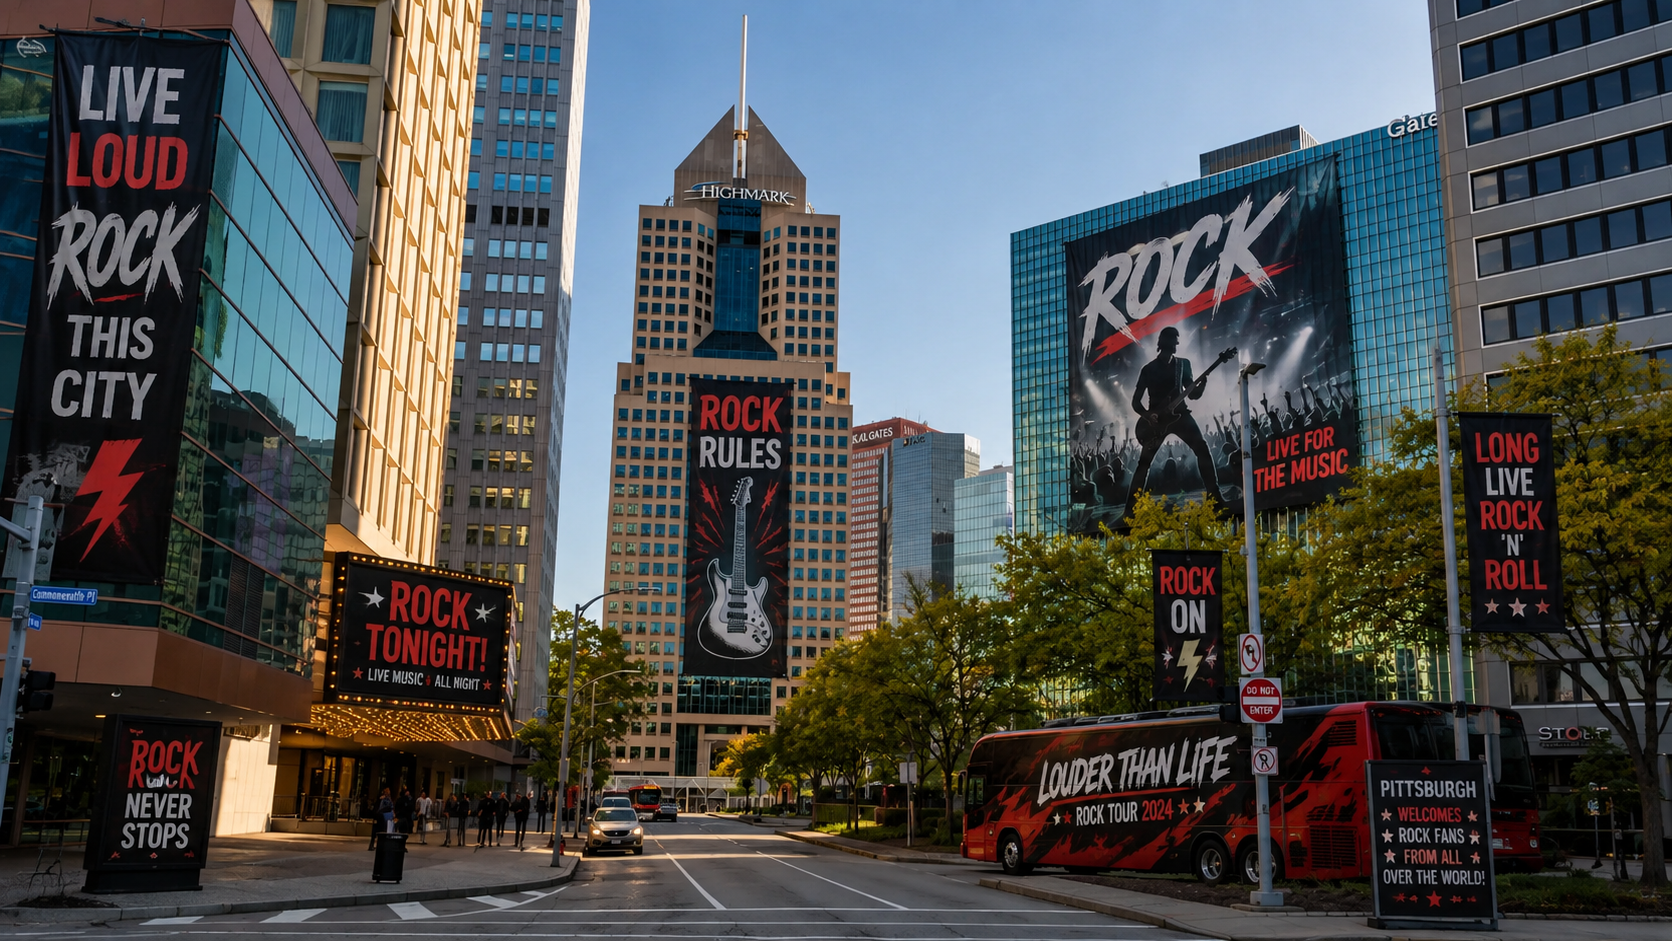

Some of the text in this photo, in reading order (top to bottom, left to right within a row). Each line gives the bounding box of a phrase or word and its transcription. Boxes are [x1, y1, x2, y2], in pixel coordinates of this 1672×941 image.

[79, 65, 184, 124] LIVE
[66, 132, 188, 190] LOUD
[702, 185, 794, 206] HIGHMARK
[47, 201, 200, 310] ROCK
[1078, 186, 1296, 366] ROCK
[67, 314, 155, 360] THIS
[51, 369, 157, 421] CITY
[700, 394, 784, 433] ROCK
[869, 427, 893, 441] GATES
[1267, 426, 1334, 462] LIVE FOR
[1475, 431, 1540, 464] LONG
[699, 435, 782, 470] RULES
[1254, 448, 1349, 493] THE MUSIC
[1485, 467, 1534, 496] LIVE
[1480, 500, 1545, 530] ROCK
[1160, 565, 1216, 596] ROCK
[1484, 559, 1548, 590] ROLL
[389, 580, 472, 631] ROCK
[1171, 599, 1206, 634] ON
[366, 623, 488, 672] TONIGHT!
[368, 667, 481, 691] LIVE MUSIC ALL NIGHT
[1246, 686, 1275, 695] DO NOT
[1249, 706, 1274, 715] ENTER
[127, 739, 203, 789] ROCK
[1037, 735, 1238, 807] LOUDER THAN LIFE
[1380, 780, 1477, 798] PITTSBURGH
[124, 793, 192, 819] NEVER
[1076, 798, 1174, 826] ROCK TOUR 2024
[1397, 806, 1462, 823] WELCOMES
[120, 822, 190, 849] STOPS
[1398, 827, 1465, 844] ROCK FANS
[1404, 849, 1463, 865] FROM ALL
[1383, 869, 1485, 886] OVER THE WORLD!
